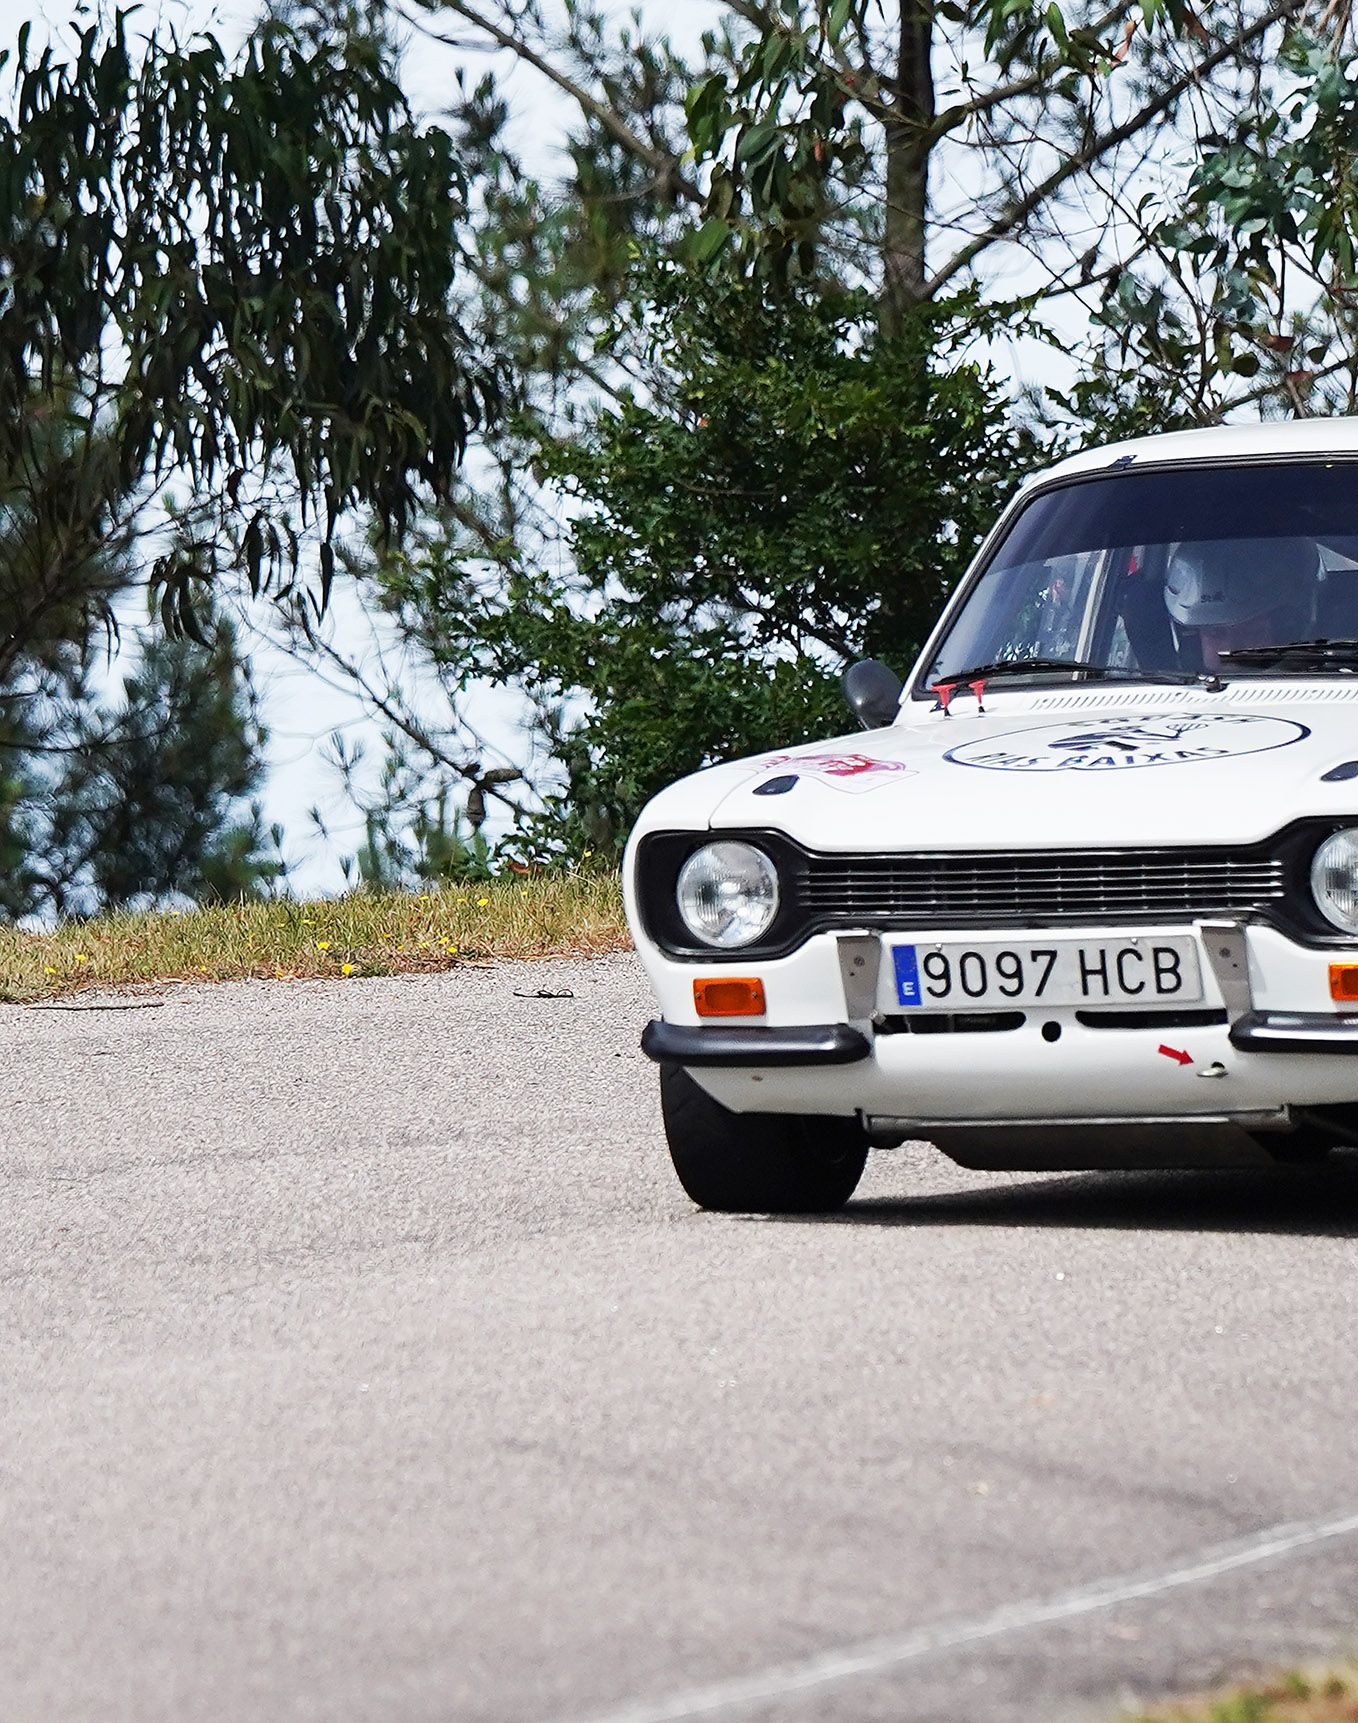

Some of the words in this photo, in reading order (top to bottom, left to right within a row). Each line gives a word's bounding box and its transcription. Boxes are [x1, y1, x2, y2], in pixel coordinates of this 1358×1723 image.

[1057, 747, 1230, 768] BAIXAS
[923, 949, 1058, 998] 9097
[1078, 946, 1183, 996] HCB
[902, 981, 915, 996] E
